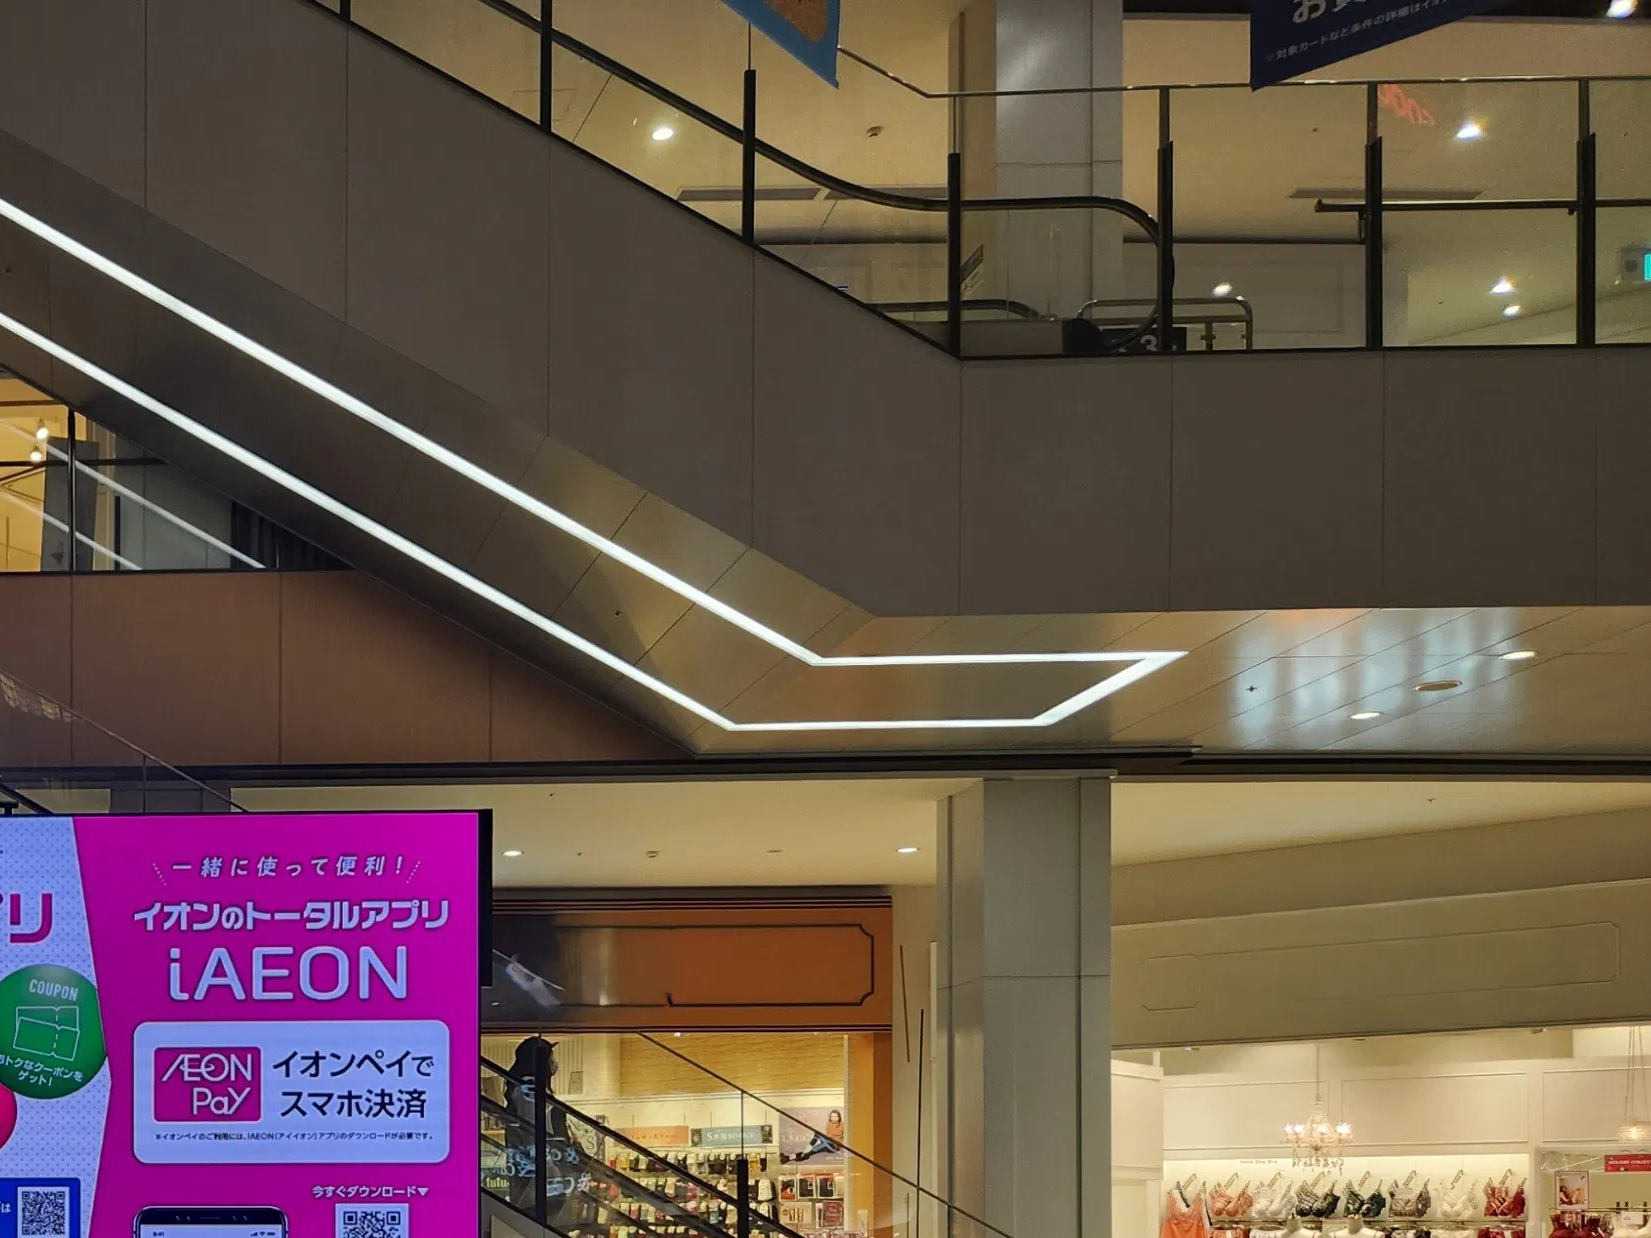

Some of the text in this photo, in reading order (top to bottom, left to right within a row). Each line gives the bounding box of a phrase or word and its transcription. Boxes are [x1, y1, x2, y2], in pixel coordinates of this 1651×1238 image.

[172, 855, 403, 877] 一緒に使って便利!
[134, 900, 449, 931] イオンのトータルアプリ
[169, 945, 408, 1001] iAEON
[29, 979, 79, 1001] COUPON
[272, 1050, 435, 1077] イオンペイで
[18, 1070, 52, 1086] ゲット!
[280, 1089, 427, 1118] スマホ決済
[312, 1185, 416, 1198] 今すぐダウンロード
